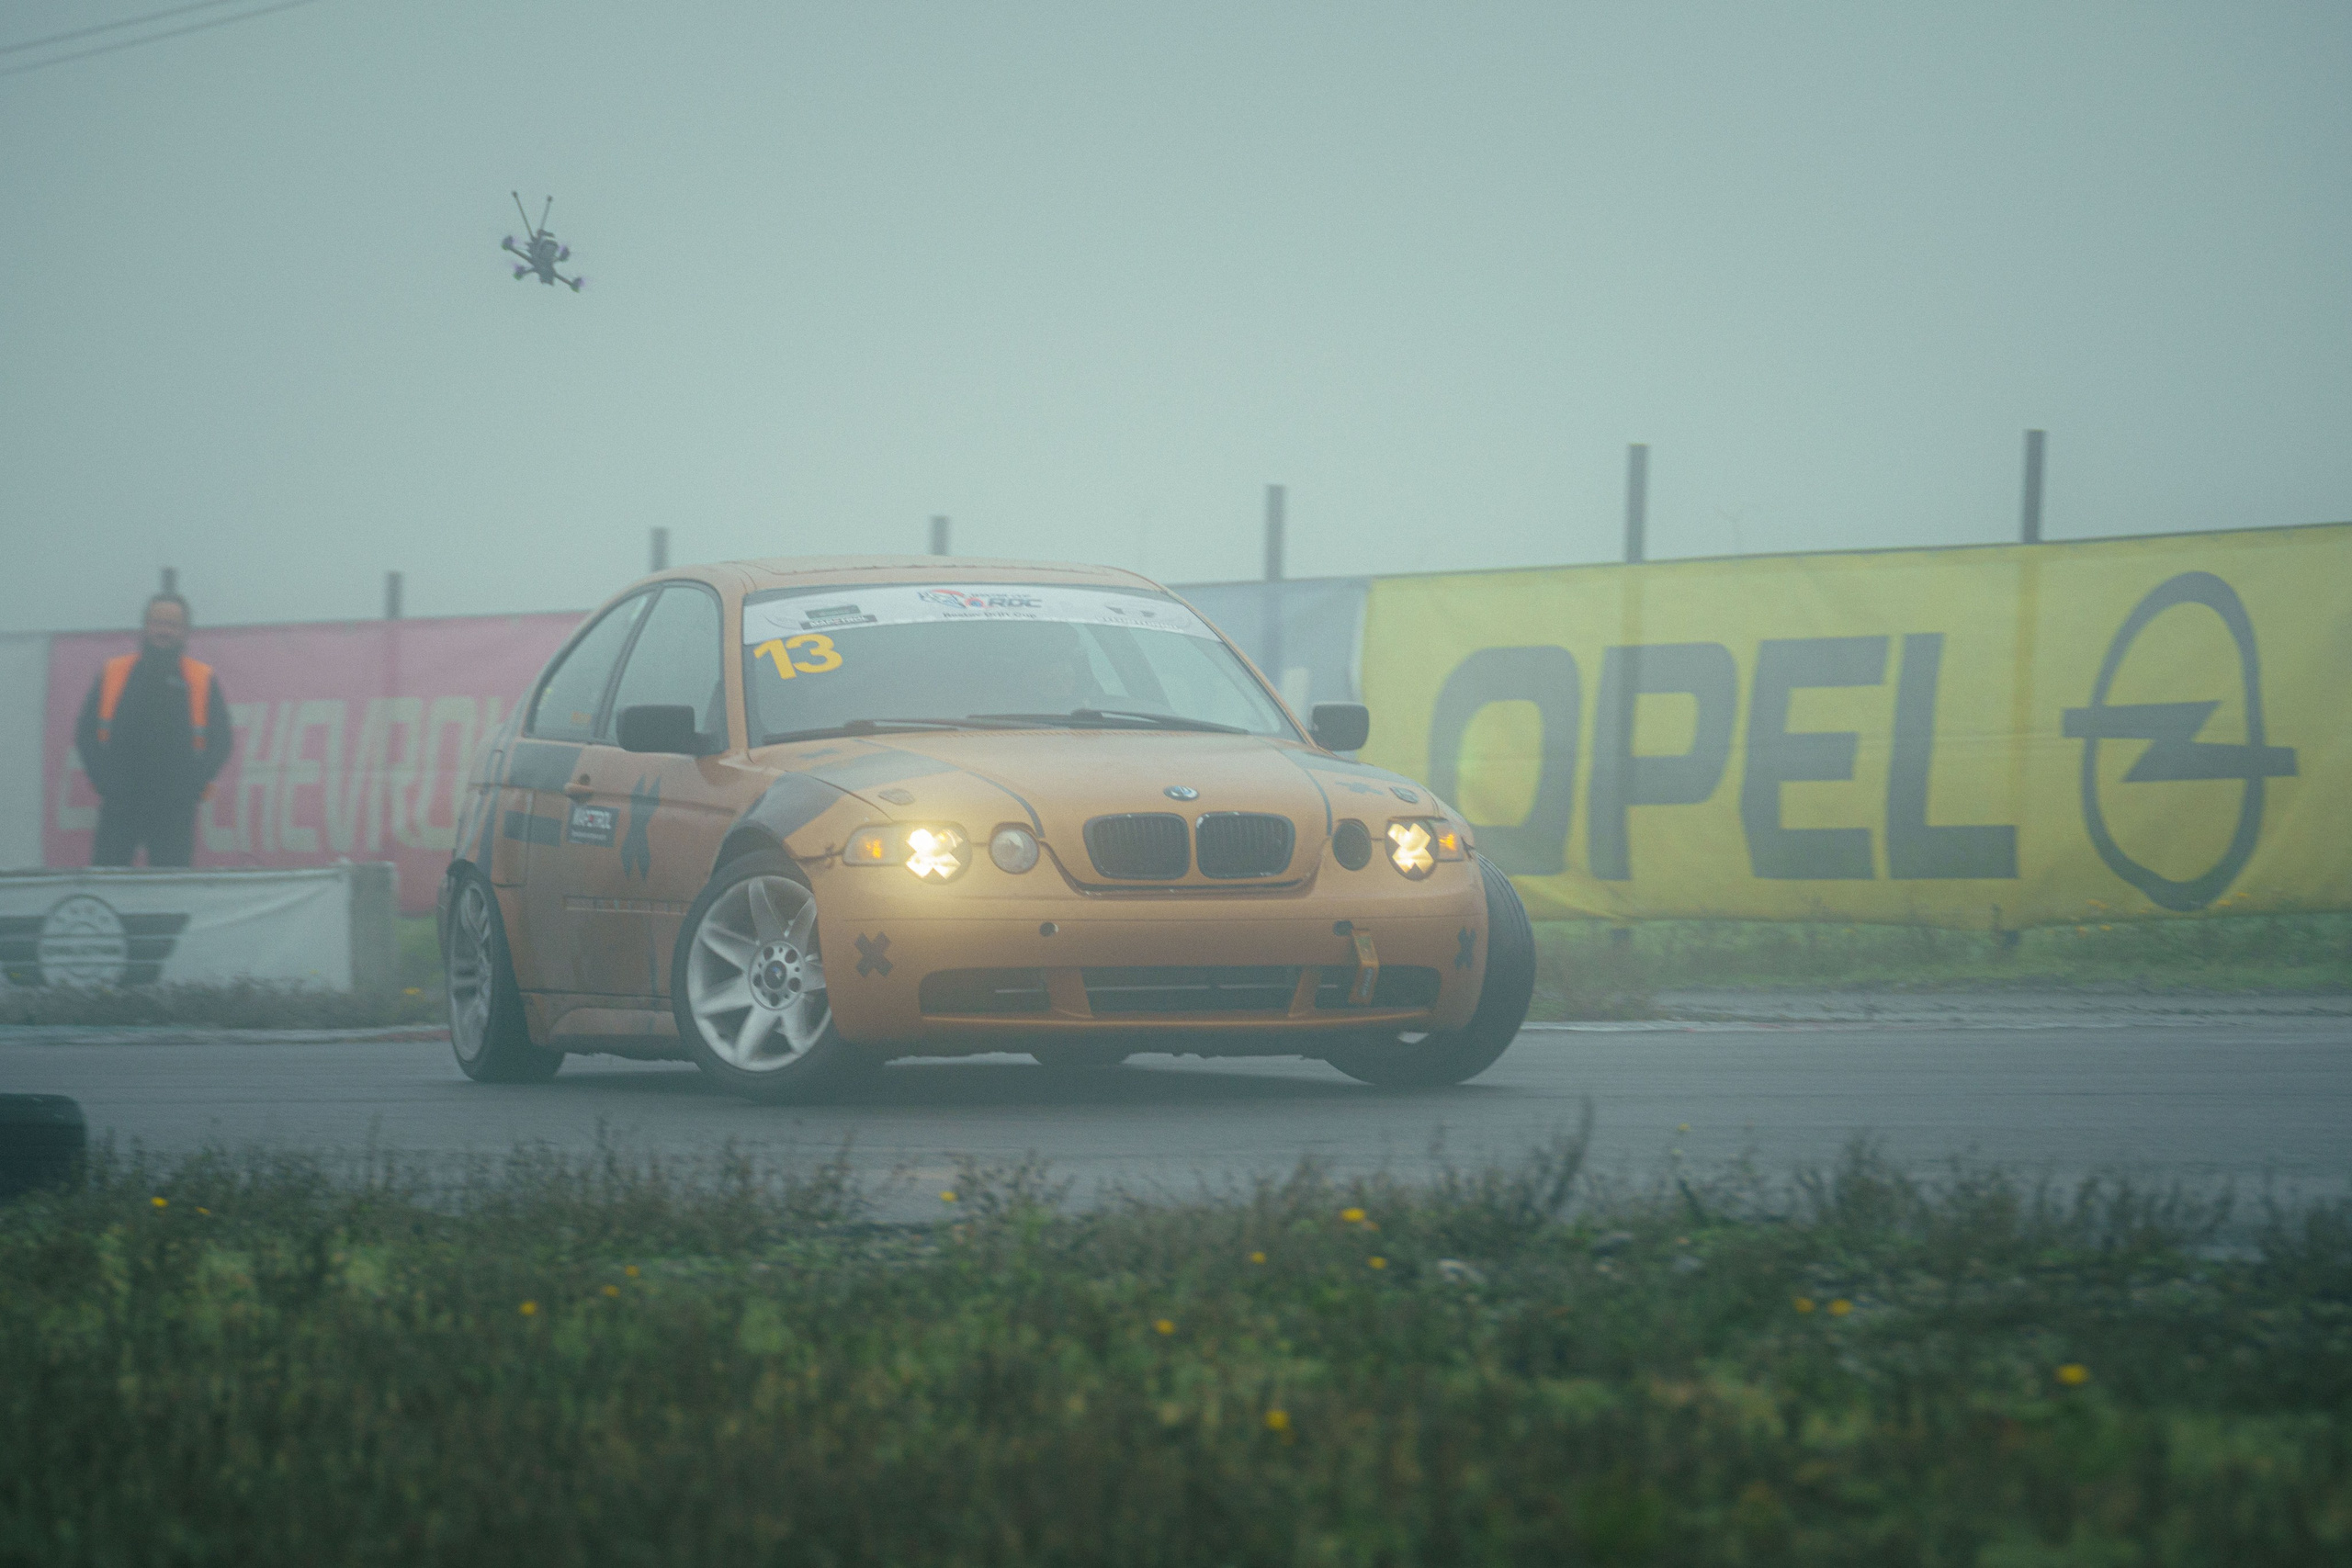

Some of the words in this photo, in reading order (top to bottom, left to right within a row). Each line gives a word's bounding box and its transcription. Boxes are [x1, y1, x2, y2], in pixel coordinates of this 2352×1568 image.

[988, 597, 1043, 608] RDC
[1012, 611, 1037, 619] Cup
[752, 633, 843, 680] 13
[1429, 632, 2018, 880] OPEL
